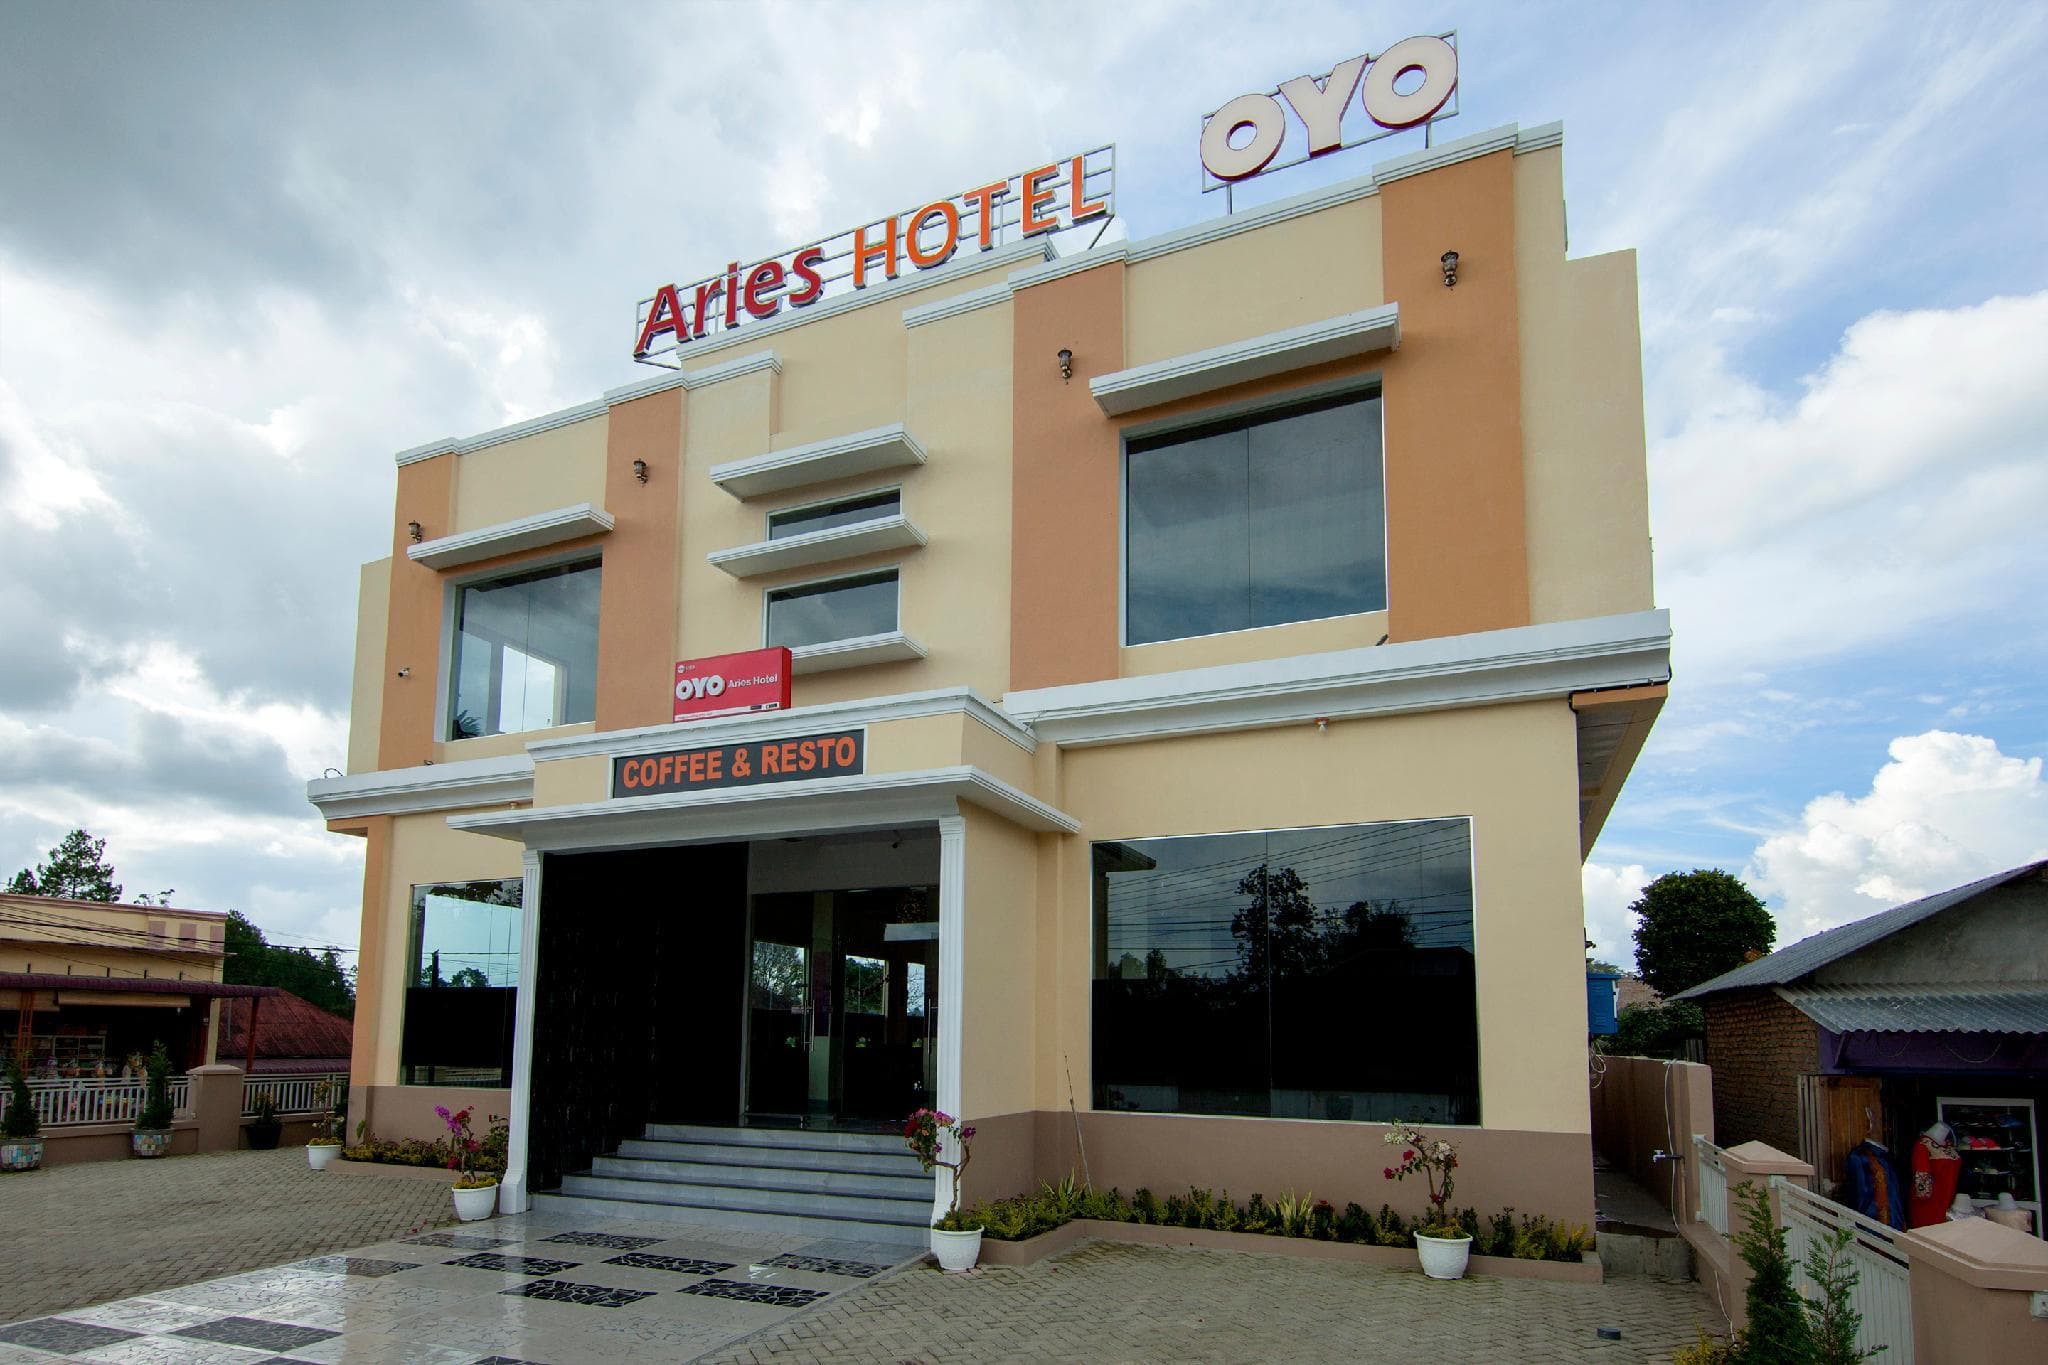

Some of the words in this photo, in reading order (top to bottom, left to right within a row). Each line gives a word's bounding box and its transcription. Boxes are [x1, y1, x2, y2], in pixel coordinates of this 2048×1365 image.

[1200, 35, 1459, 182] OYO
[633, 246, 825, 359] Aries
[853, 154, 1107, 290] HOTEL
[675, 674, 726, 701] OYO
[728, 679, 752, 688] Aries
[753, 673, 778, 685] Hotel
[623, 750, 723, 789] COFFEE
[731, 748, 751, 777] &
[761, 736, 856, 775] RESTO
